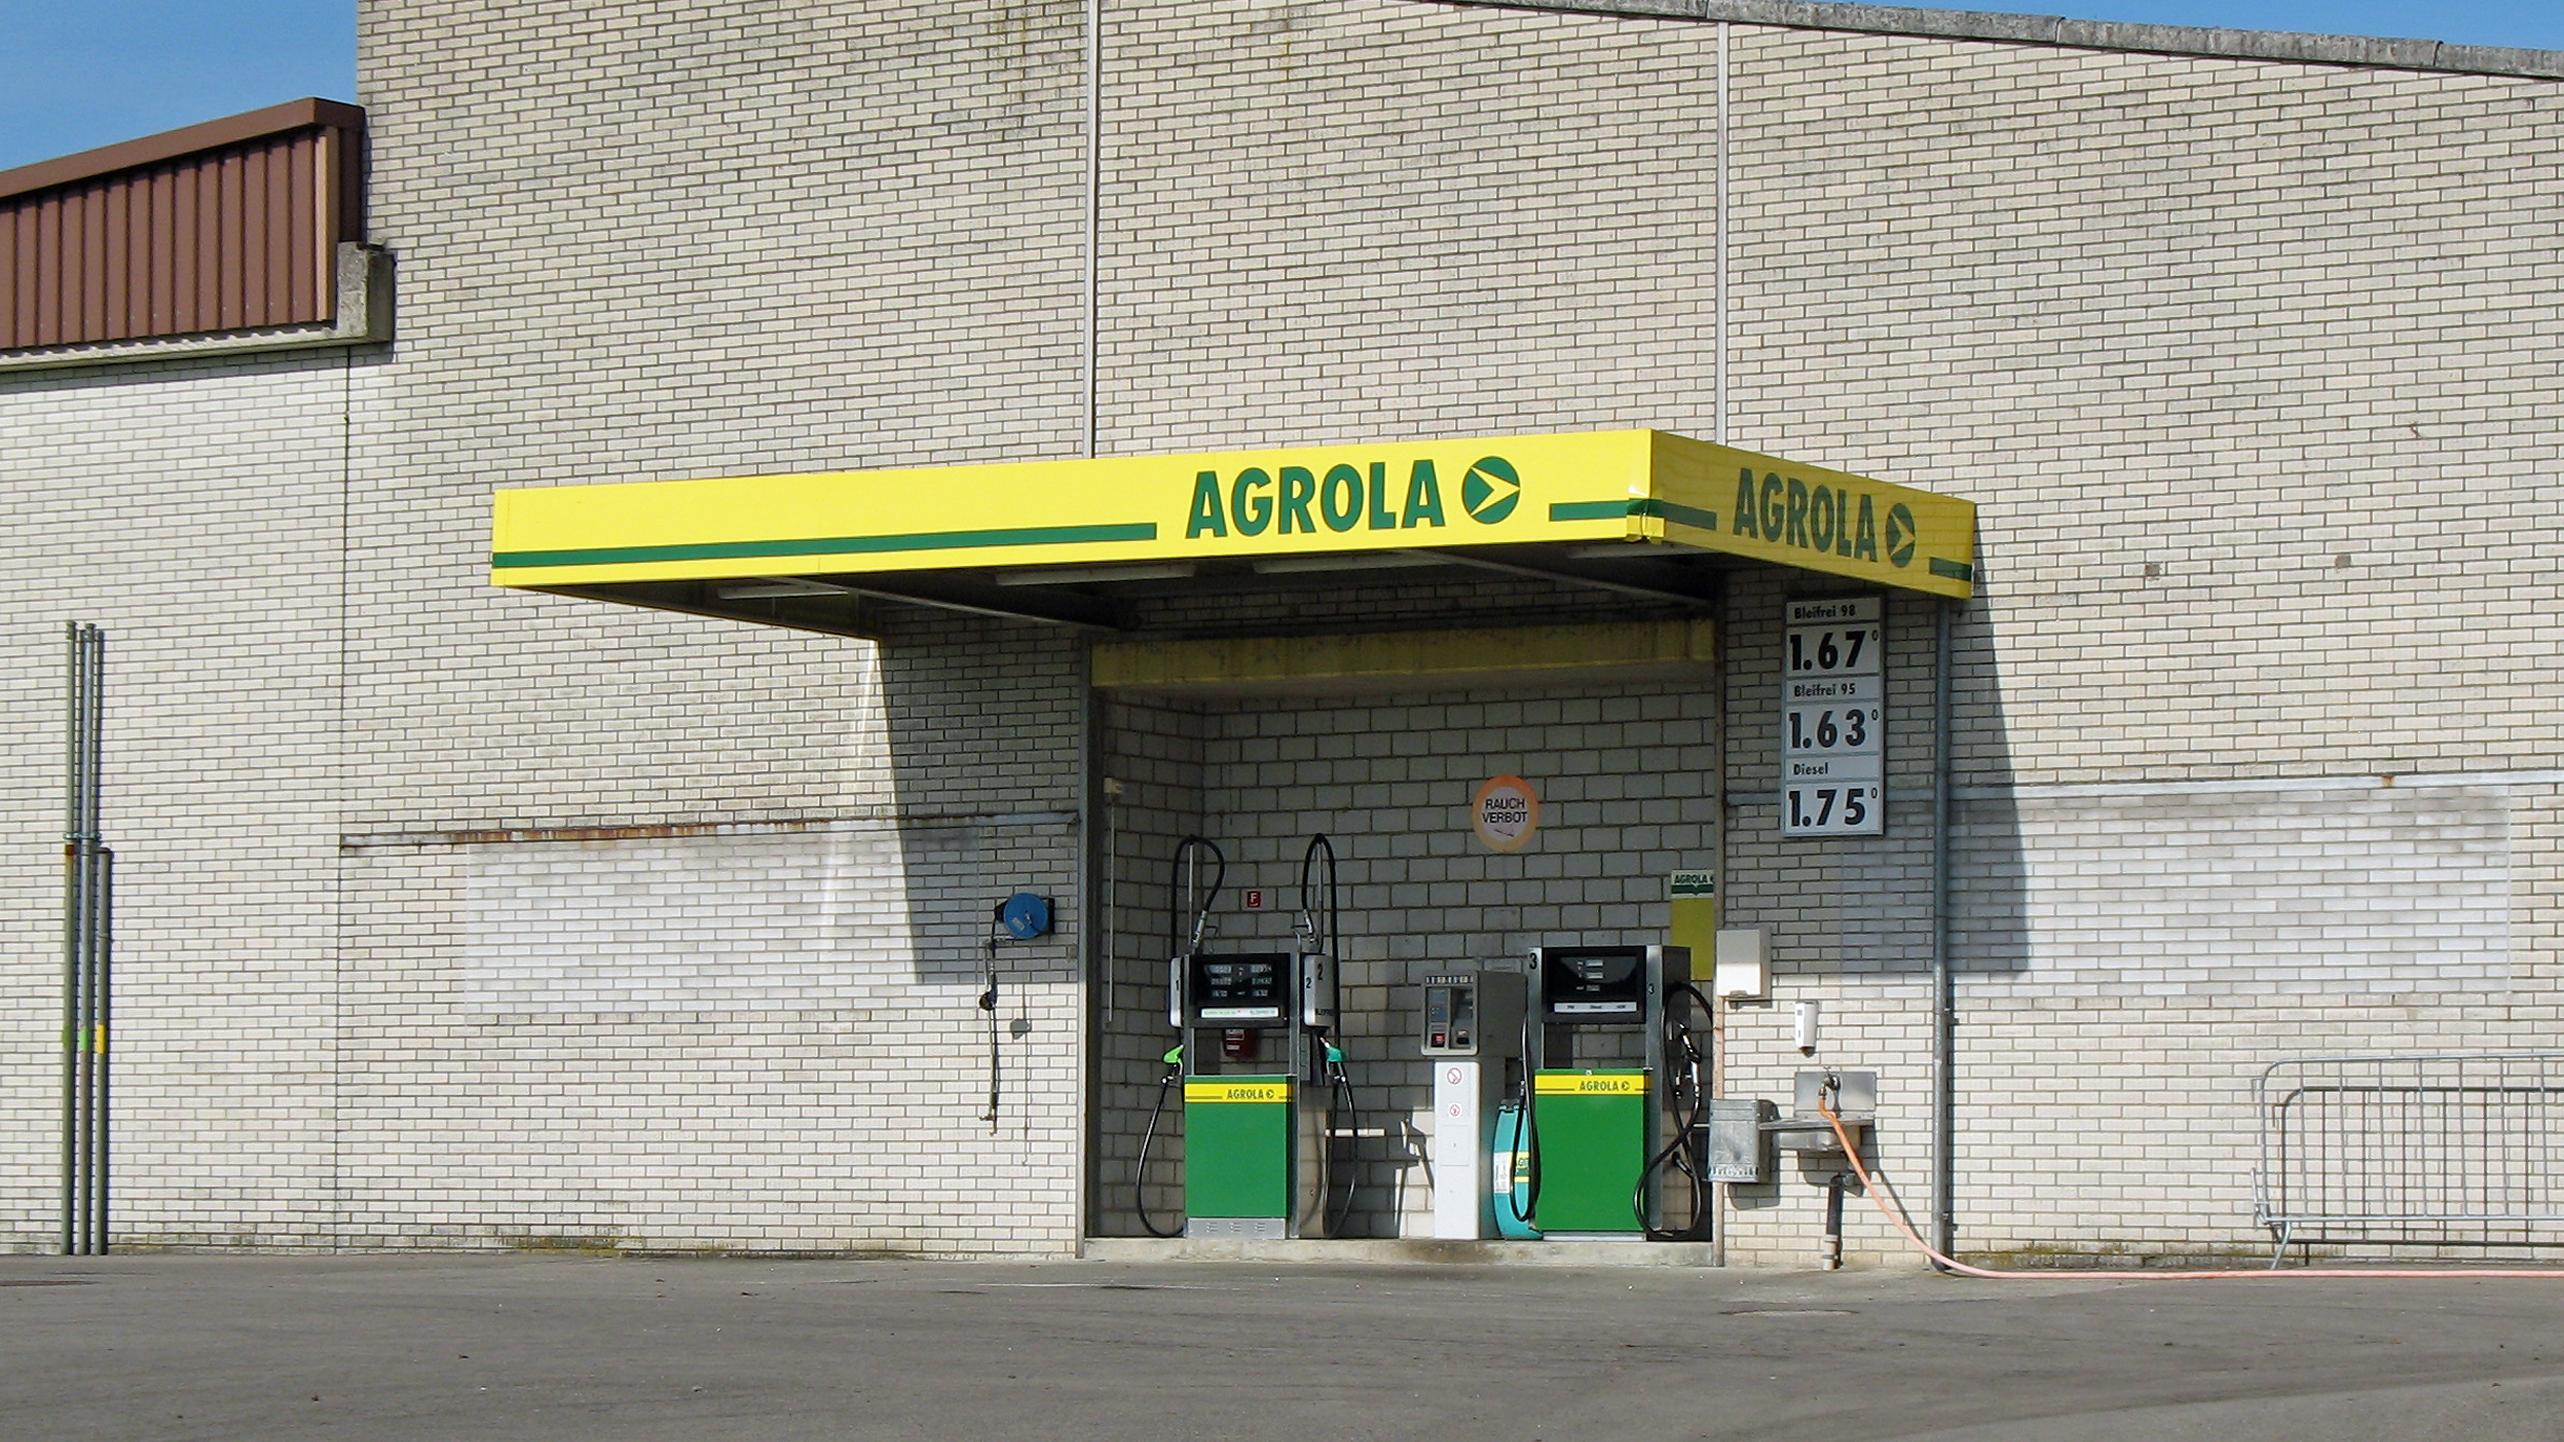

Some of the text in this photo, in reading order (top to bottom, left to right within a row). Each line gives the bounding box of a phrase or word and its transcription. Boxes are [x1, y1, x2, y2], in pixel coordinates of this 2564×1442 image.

[1186, 459, 1445, 539] AGROLA
[1733, 467, 1879, 563] AGROLA
[1794, 604, 1856, 619] Bleifrei 98
[1789, 630, 1866, 671] 1.67
[1793, 682, 1856, 697] Bleifrei 95
[1789, 708, 1866, 749] 1.63
[1793, 762, 1829, 775] Diesel
[1485, 797, 1525, 810] RAUCH
[1788, 787, 1866, 827] 1.75
[1482, 811, 1528, 823] VERBOT
[1674, 874, 1708, 884] AGROLA
[1529, 952, 1538, 970] 3
[1317, 963, 1324, 980] 2
[1305, 976, 1312, 988] 2
[1648, 983, 1655, 994] 3
[1579, 1080, 1620, 1092] AGROLA
[1226, 1088, 1264, 1100] AGROLA
